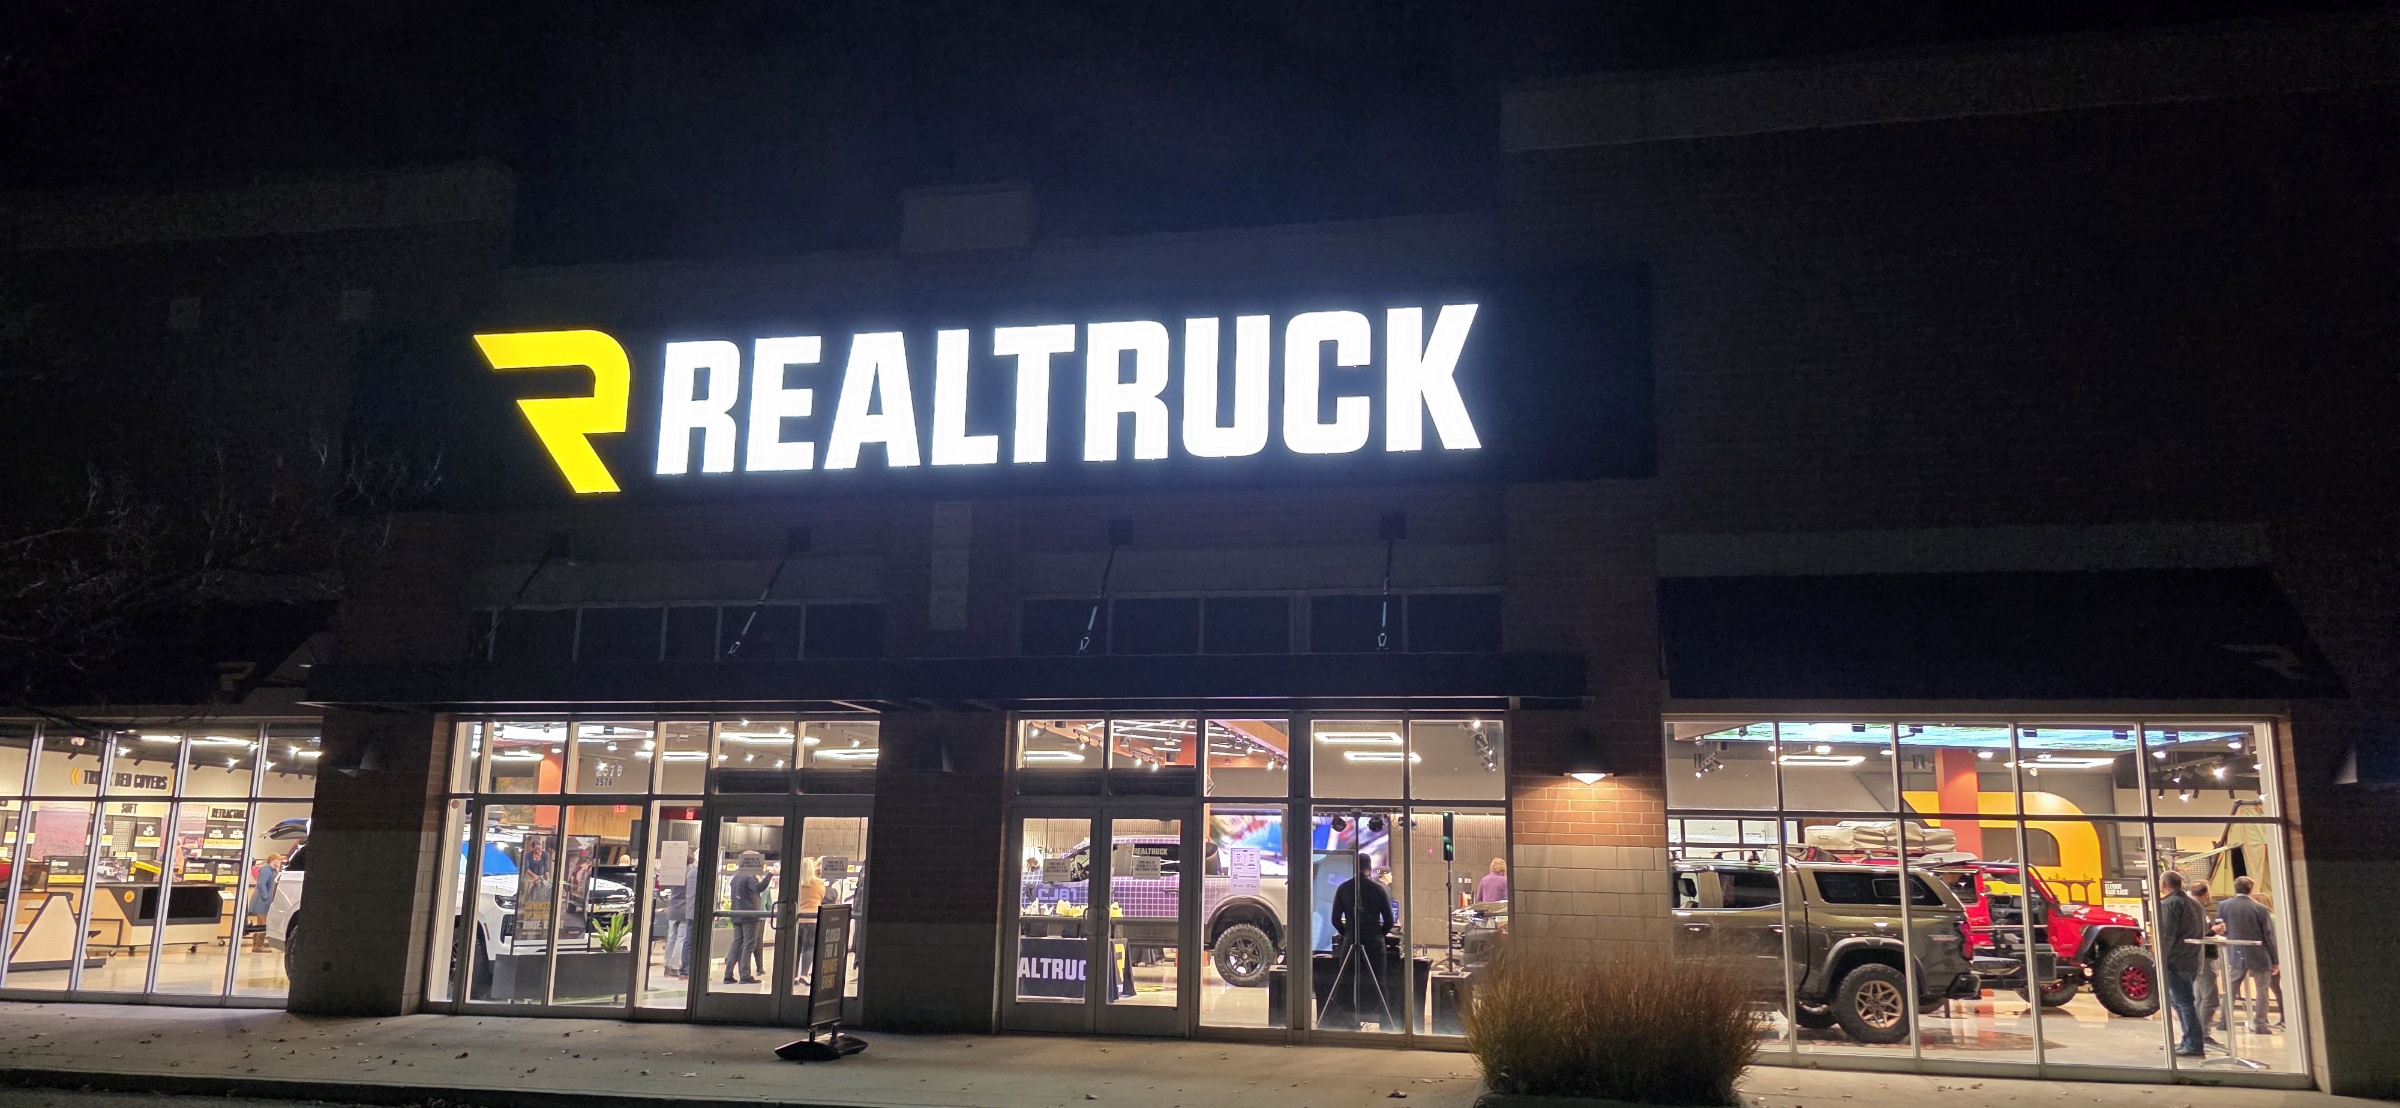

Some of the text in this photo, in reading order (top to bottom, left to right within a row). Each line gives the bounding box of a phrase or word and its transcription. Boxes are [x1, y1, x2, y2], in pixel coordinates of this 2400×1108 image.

[655, 303, 1482, 475] REALTRUCK
[83, 770, 168, 790] TRK BED COVERS
[595, 778, 613, 787] 2576
[121, 803, 138, 814] SOFT
[825, 927, 841, 943] CLOSED
[825, 943, 838, 959] FOR A
[821, 974, 836, 990] EVENT
